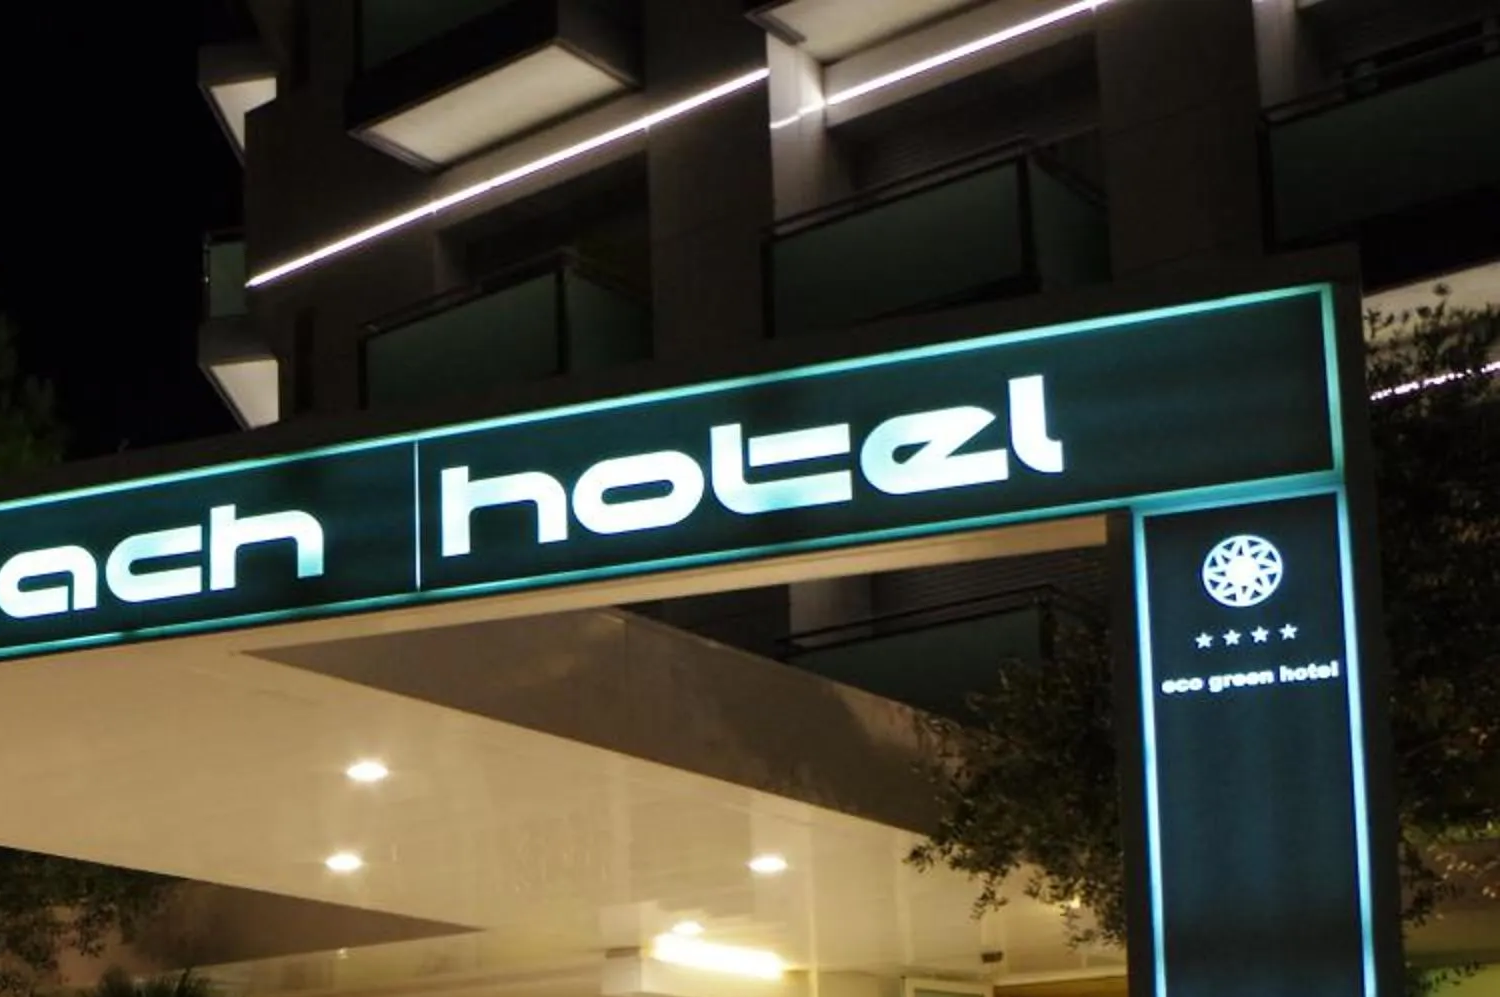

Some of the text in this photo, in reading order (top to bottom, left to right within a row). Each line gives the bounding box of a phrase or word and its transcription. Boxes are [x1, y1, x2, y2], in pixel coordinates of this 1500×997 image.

[439, 373, 1065, 560] hotel
[1161, 659, 1340, 694] eco green hotel
